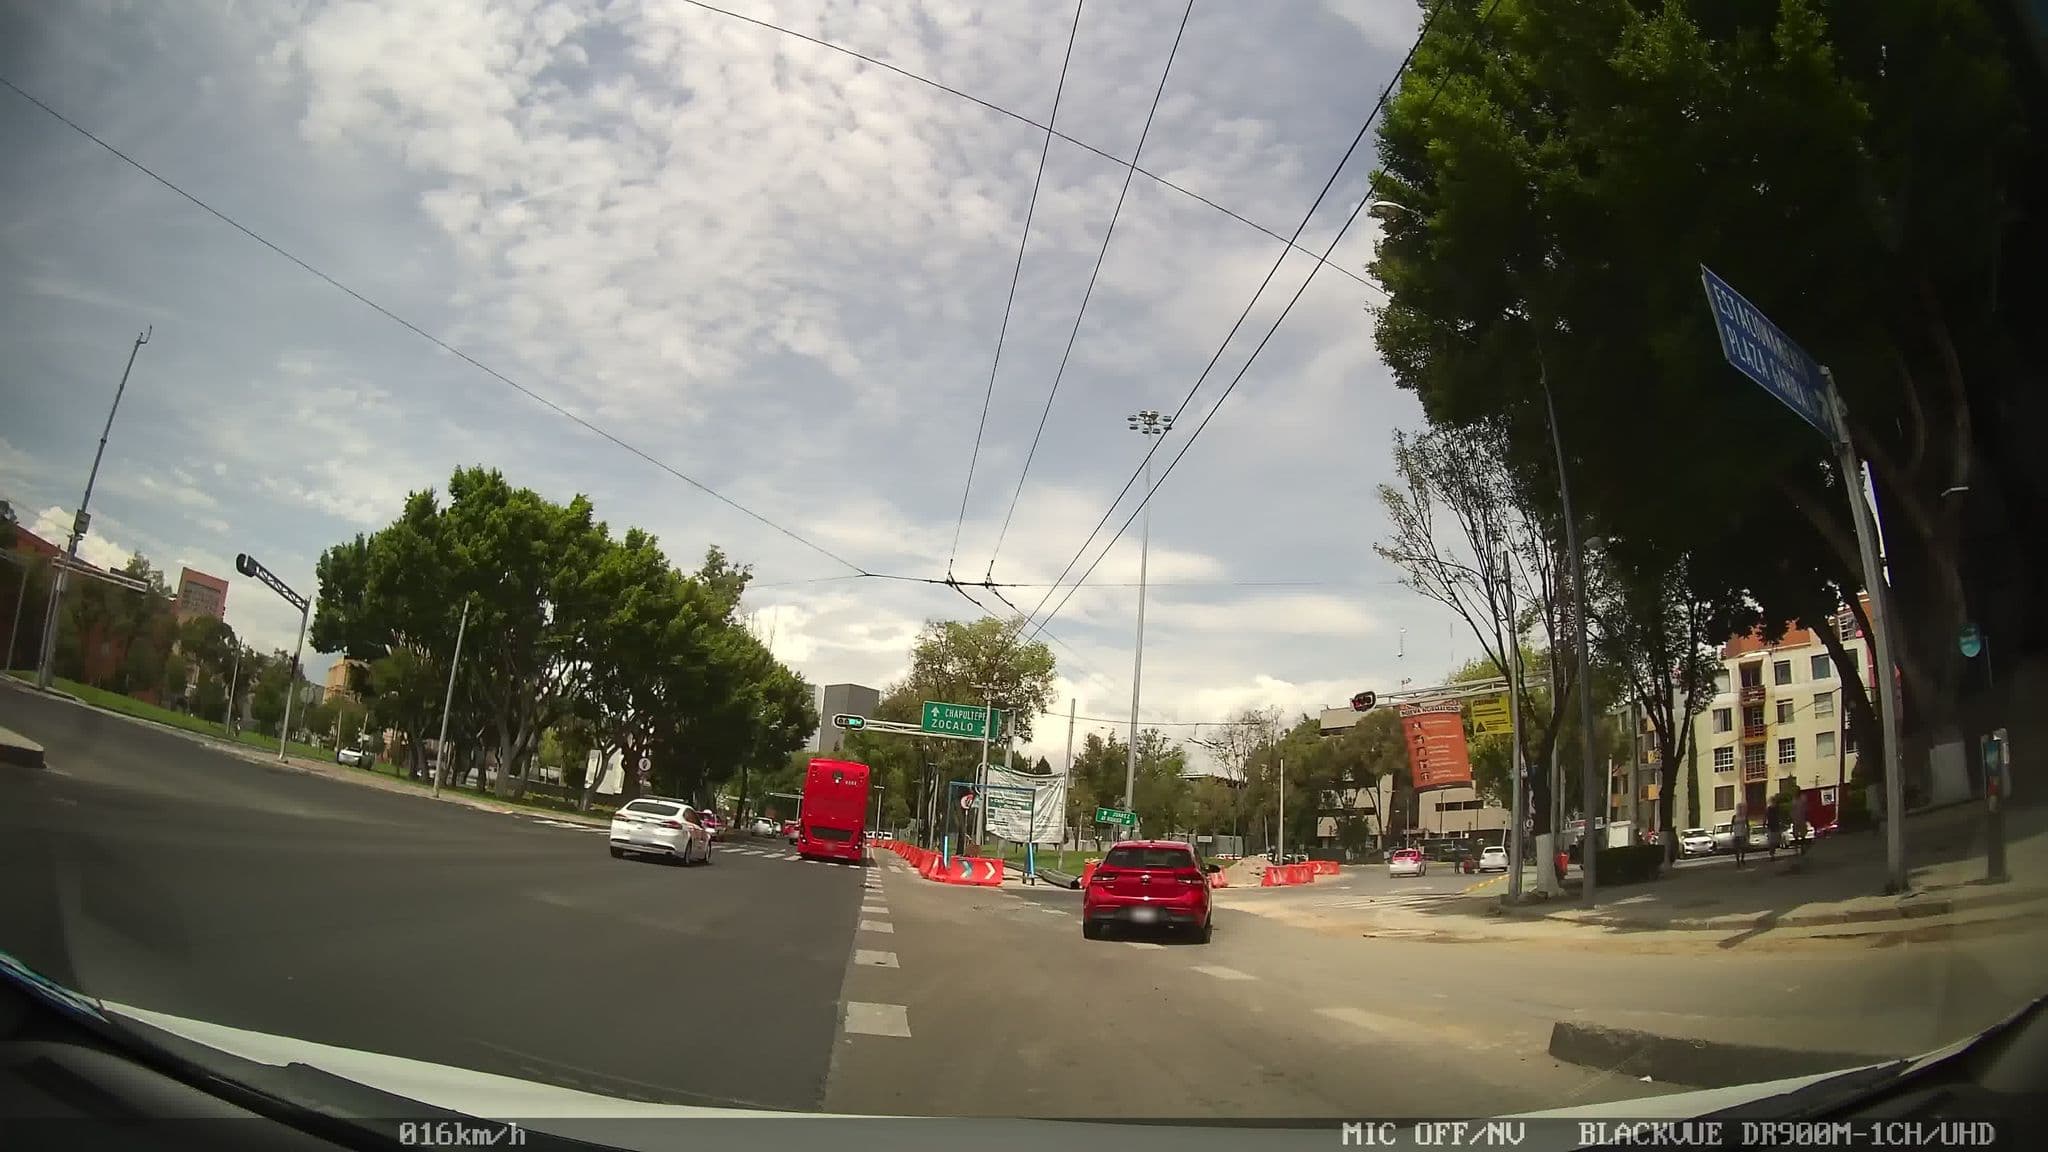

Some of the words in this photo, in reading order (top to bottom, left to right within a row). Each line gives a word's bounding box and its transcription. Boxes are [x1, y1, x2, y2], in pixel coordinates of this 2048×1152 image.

[1725, 324, 1770, 381] PLAZA
[945, 708, 987, 721] CHAPULTEPE
[931, 719, 973, 731] ZOCALO
